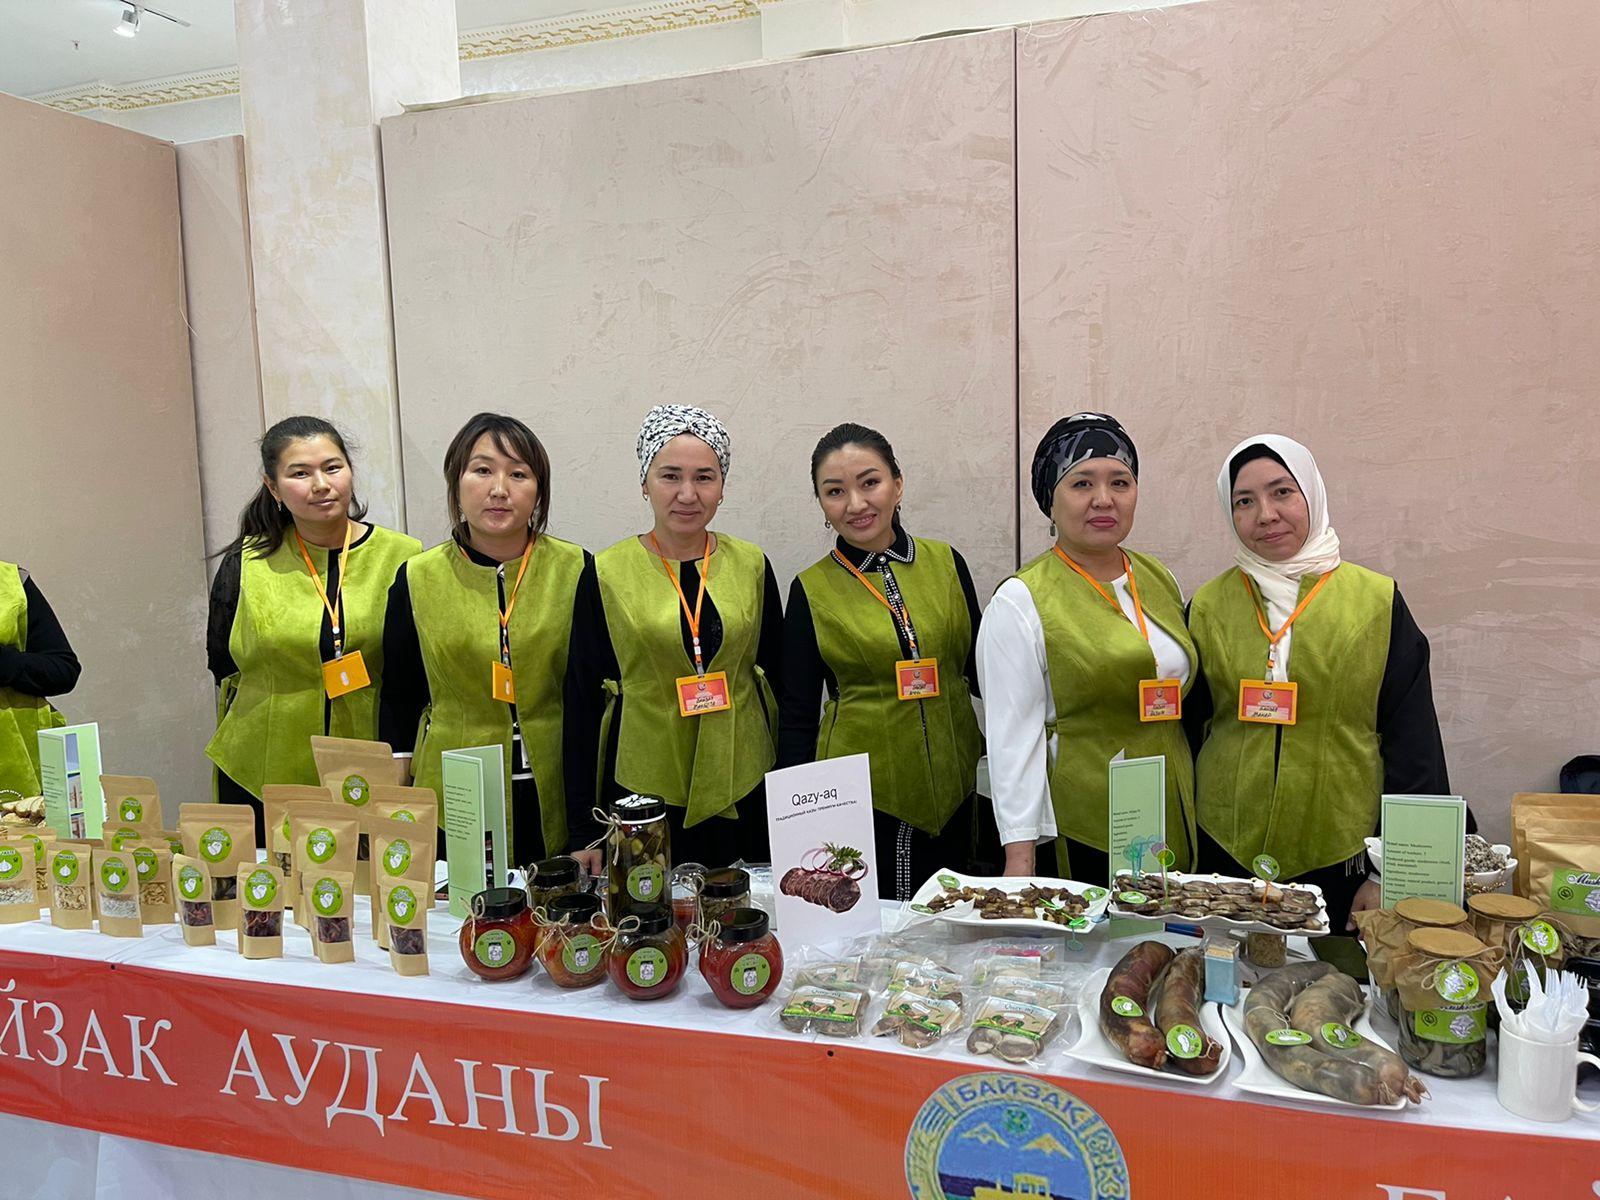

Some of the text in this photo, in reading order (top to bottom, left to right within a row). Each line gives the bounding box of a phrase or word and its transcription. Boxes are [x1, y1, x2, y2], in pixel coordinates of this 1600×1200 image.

[792, 788, 838, 806] Qazy-aq
[220, 1028, 612, 1150] АУДАНЫ
[956, 1077, 1088, 1128] БАЙЗАК
